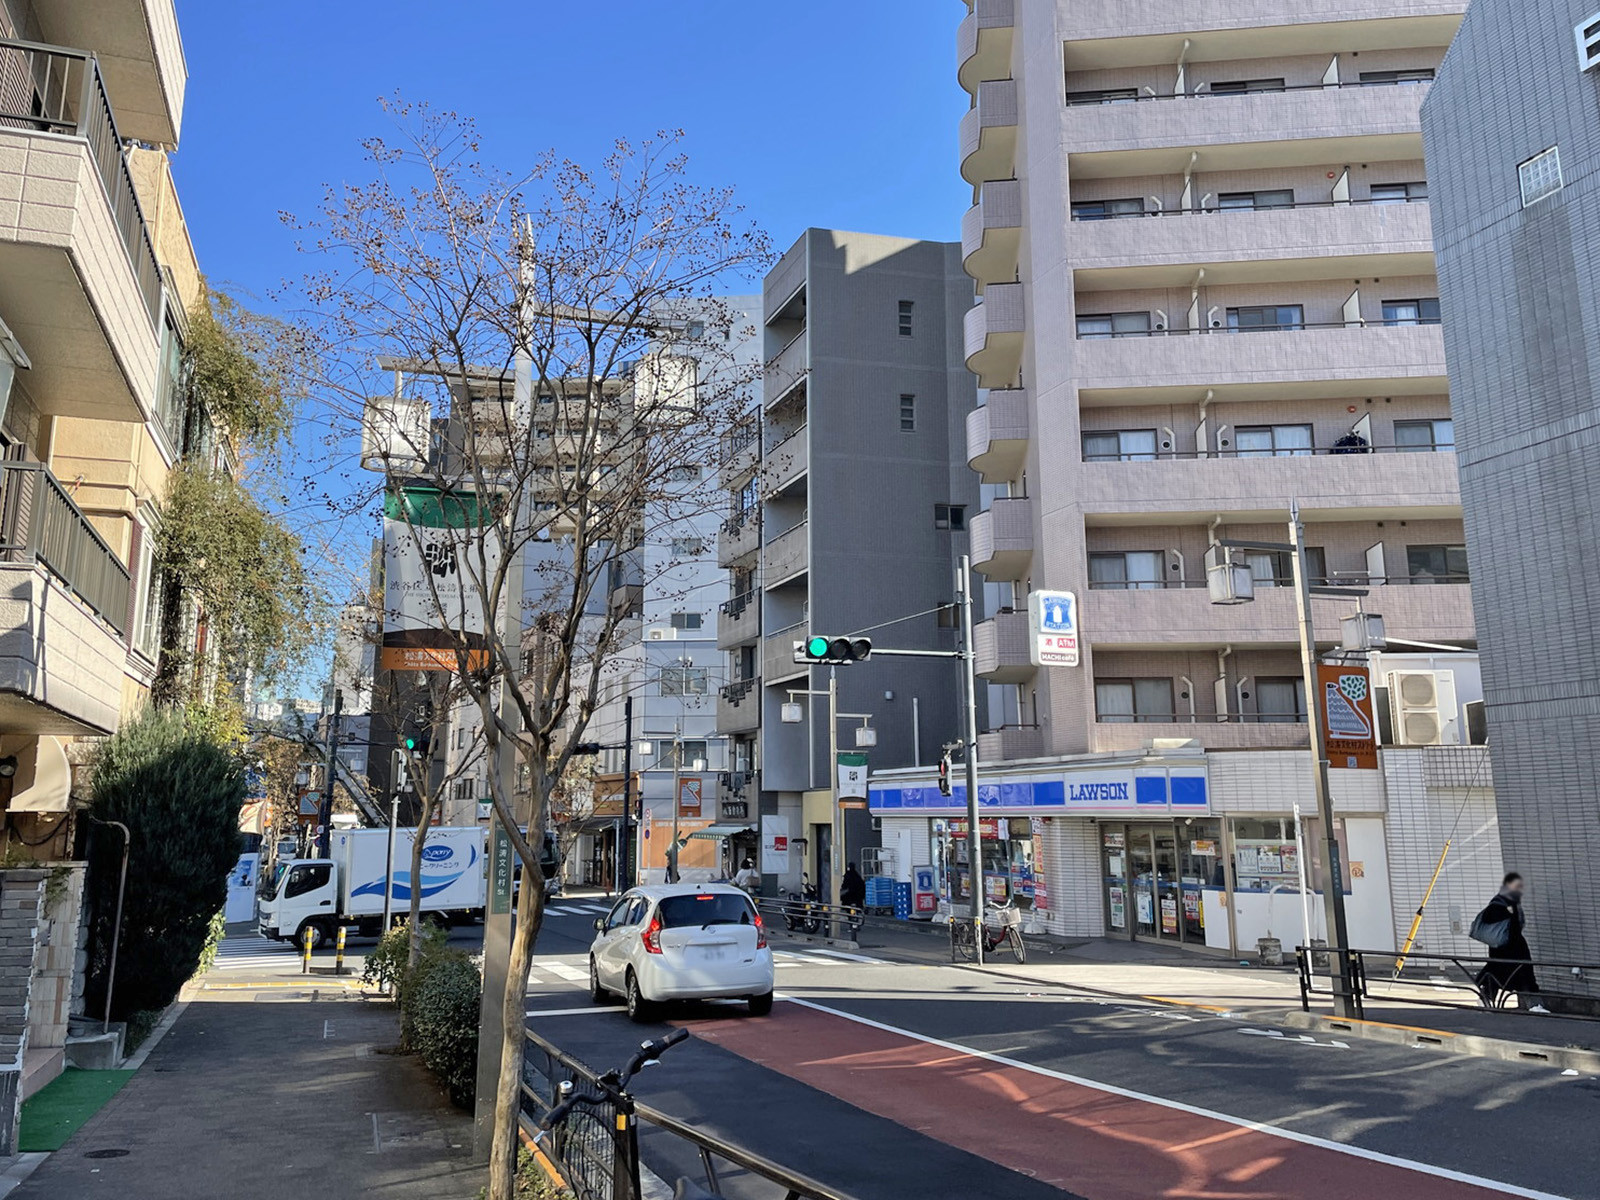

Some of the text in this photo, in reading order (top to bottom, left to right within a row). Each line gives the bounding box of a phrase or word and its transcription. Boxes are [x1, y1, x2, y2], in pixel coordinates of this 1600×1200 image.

[1058, 639, 1075, 648] ATM
[1069, 782, 1129, 801] LAWSON
[420, 861, 459, 870] ニークリーニング
